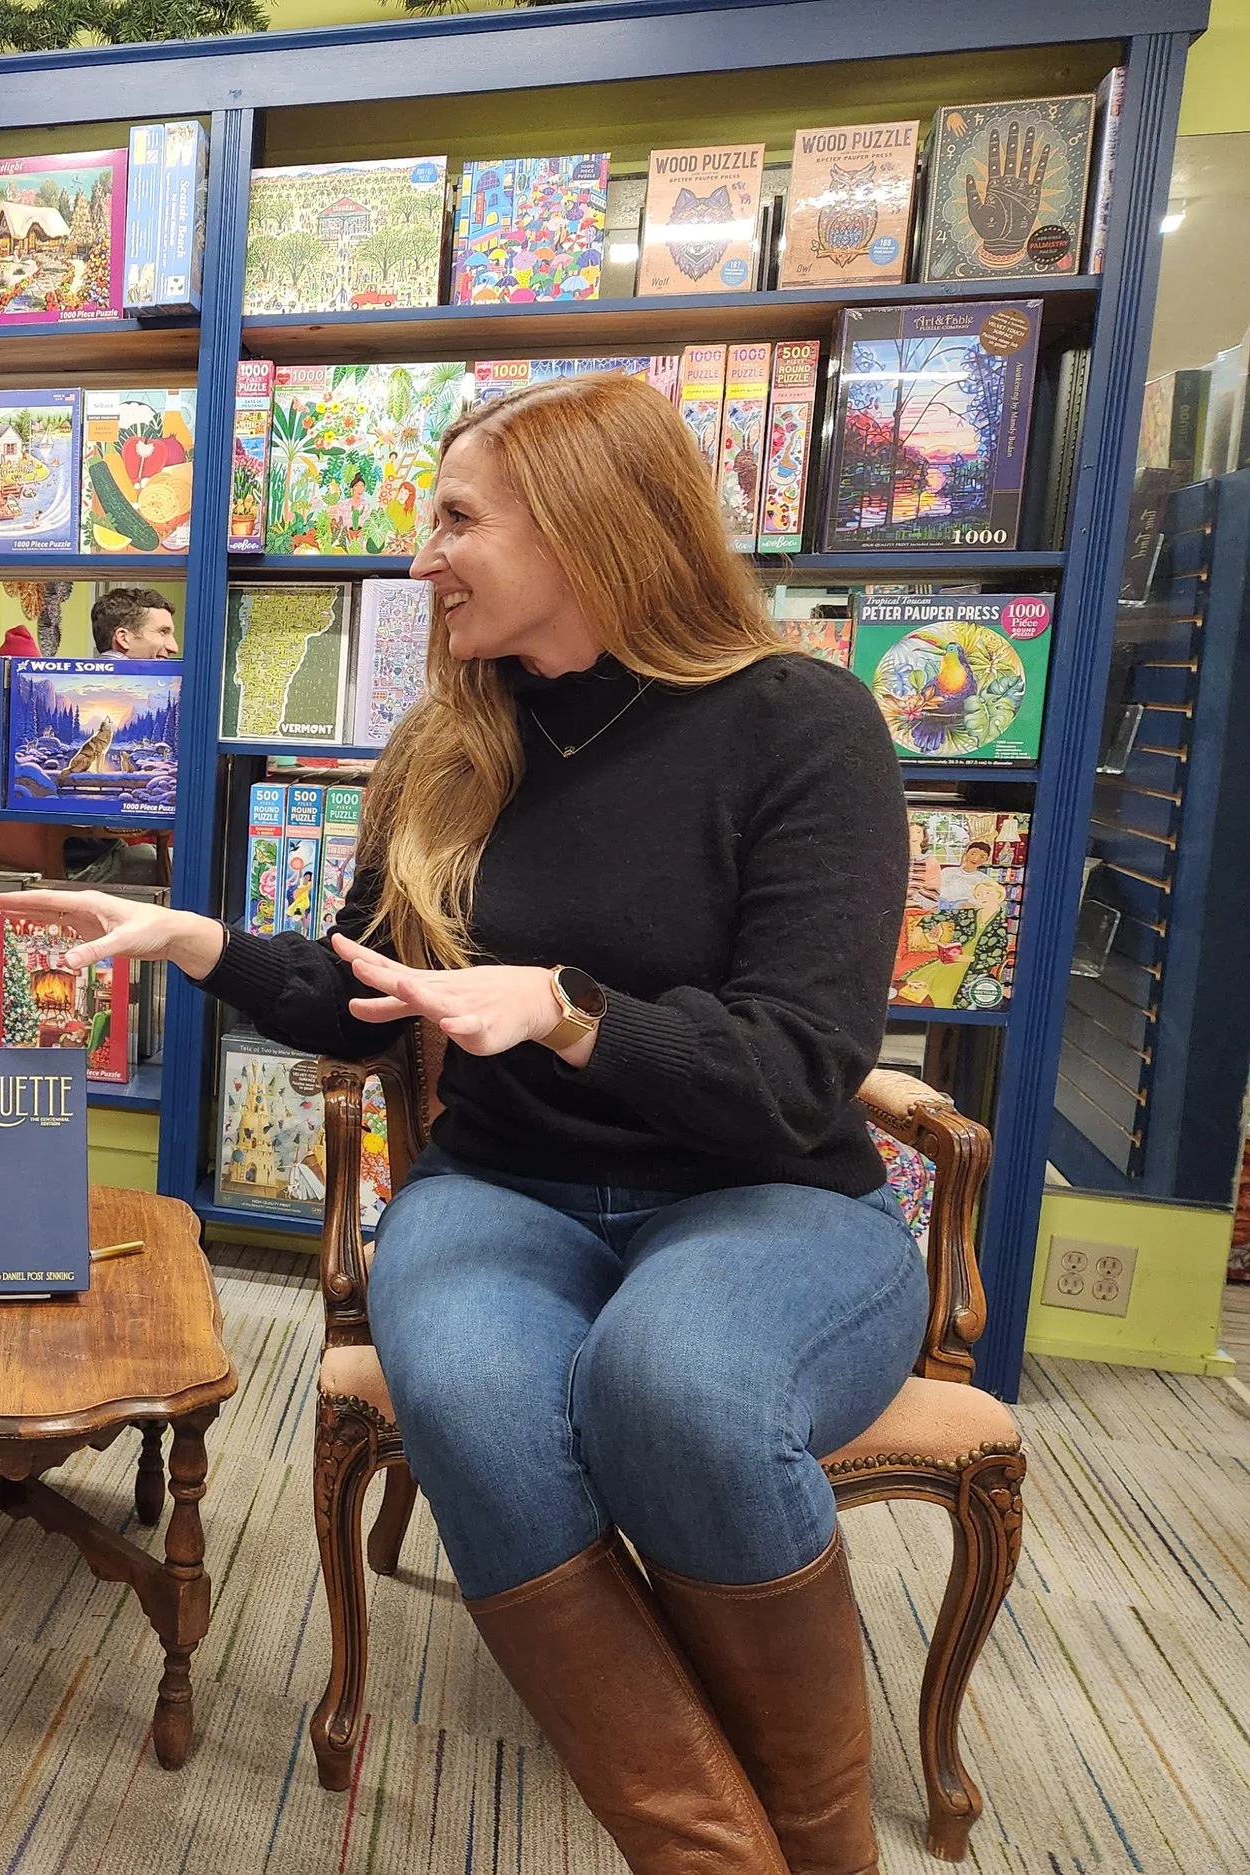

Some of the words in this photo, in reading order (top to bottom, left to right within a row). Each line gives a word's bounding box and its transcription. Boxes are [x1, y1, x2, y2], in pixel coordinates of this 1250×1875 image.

[802, 132, 846, 154] WOOD
[852, 128, 912, 150] PUZZLE
[655, 155, 697, 174] WOOD
[702, 150, 759, 171] PUZZLE
[179, 180, 190, 223] Seaside
[177, 225, 187, 259] Beach
[1030, 241, 1068, 249] PALMISTRY
[651, 277, 670, 286] Wolf
[60, 310, 76, 318] 1000
[77, 309, 94, 317] Piece
[96, 309, 118, 317] Puzzle
[689, 350, 721, 363] 1000
[733, 348, 766, 361] 1000
[782, 346, 810, 359] 500
[240, 364, 269, 376] 1000
[493, 364, 528, 377] 1000
[687, 369, 719, 379] PUZZLE
[731, 368, 763, 379] PUZZLE
[779, 365, 810, 373] ROUND
[293, 369, 323, 382] 1000
[778, 373, 809, 383] PUZZLE
[237, 382, 267, 392] PUZZLE
[1012, 362, 1024, 401] Awakening
[1012, 402, 1020, 410] by
[1007, 411, 1018, 435] Mandy
[1007, 436, 1015, 457] Budan
[951, 529, 1007, 545] 1000
[13, 541, 30, 549] 1000
[49, 540, 71, 548] Puzzle
[866, 597, 899, 607] Tropical
[901, 596, 931, 605] Toucan
[862, 606, 901, 621] PETER
[904, 605, 954, 620] PAUPER
[957, 605, 1000, 620] PRESS
[1007, 603, 1046, 618] 1000
[1011, 618, 1038, 627] Piece
[30, 661, 71, 672] WOLF
[75, 661, 114, 672] SONG
[281, 724, 334, 735] VERMONT
[256, 790, 279, 801] 500
[293, 791, 317, 802] 500
[330, 793, 358, 805] 1000
[123, 803, 138, 811] 1000
[139, 804, 157, 812] Piece
[158, 804, 176, 812] Puzz
[291, 806, 318, 814] ROUND
[253, 813, 278, 821] PUZZLE
[290, 814, 316, 822] PUZZLE
[330, 810, 357, 820] PUZZLE
[100, 1070, 122, 1078] Puzzle
[2, 1271, 26, 1281] DANIEL
[27, 1271, 44, 1281] POST
[45, 1271, 75, 1281] SENNING
